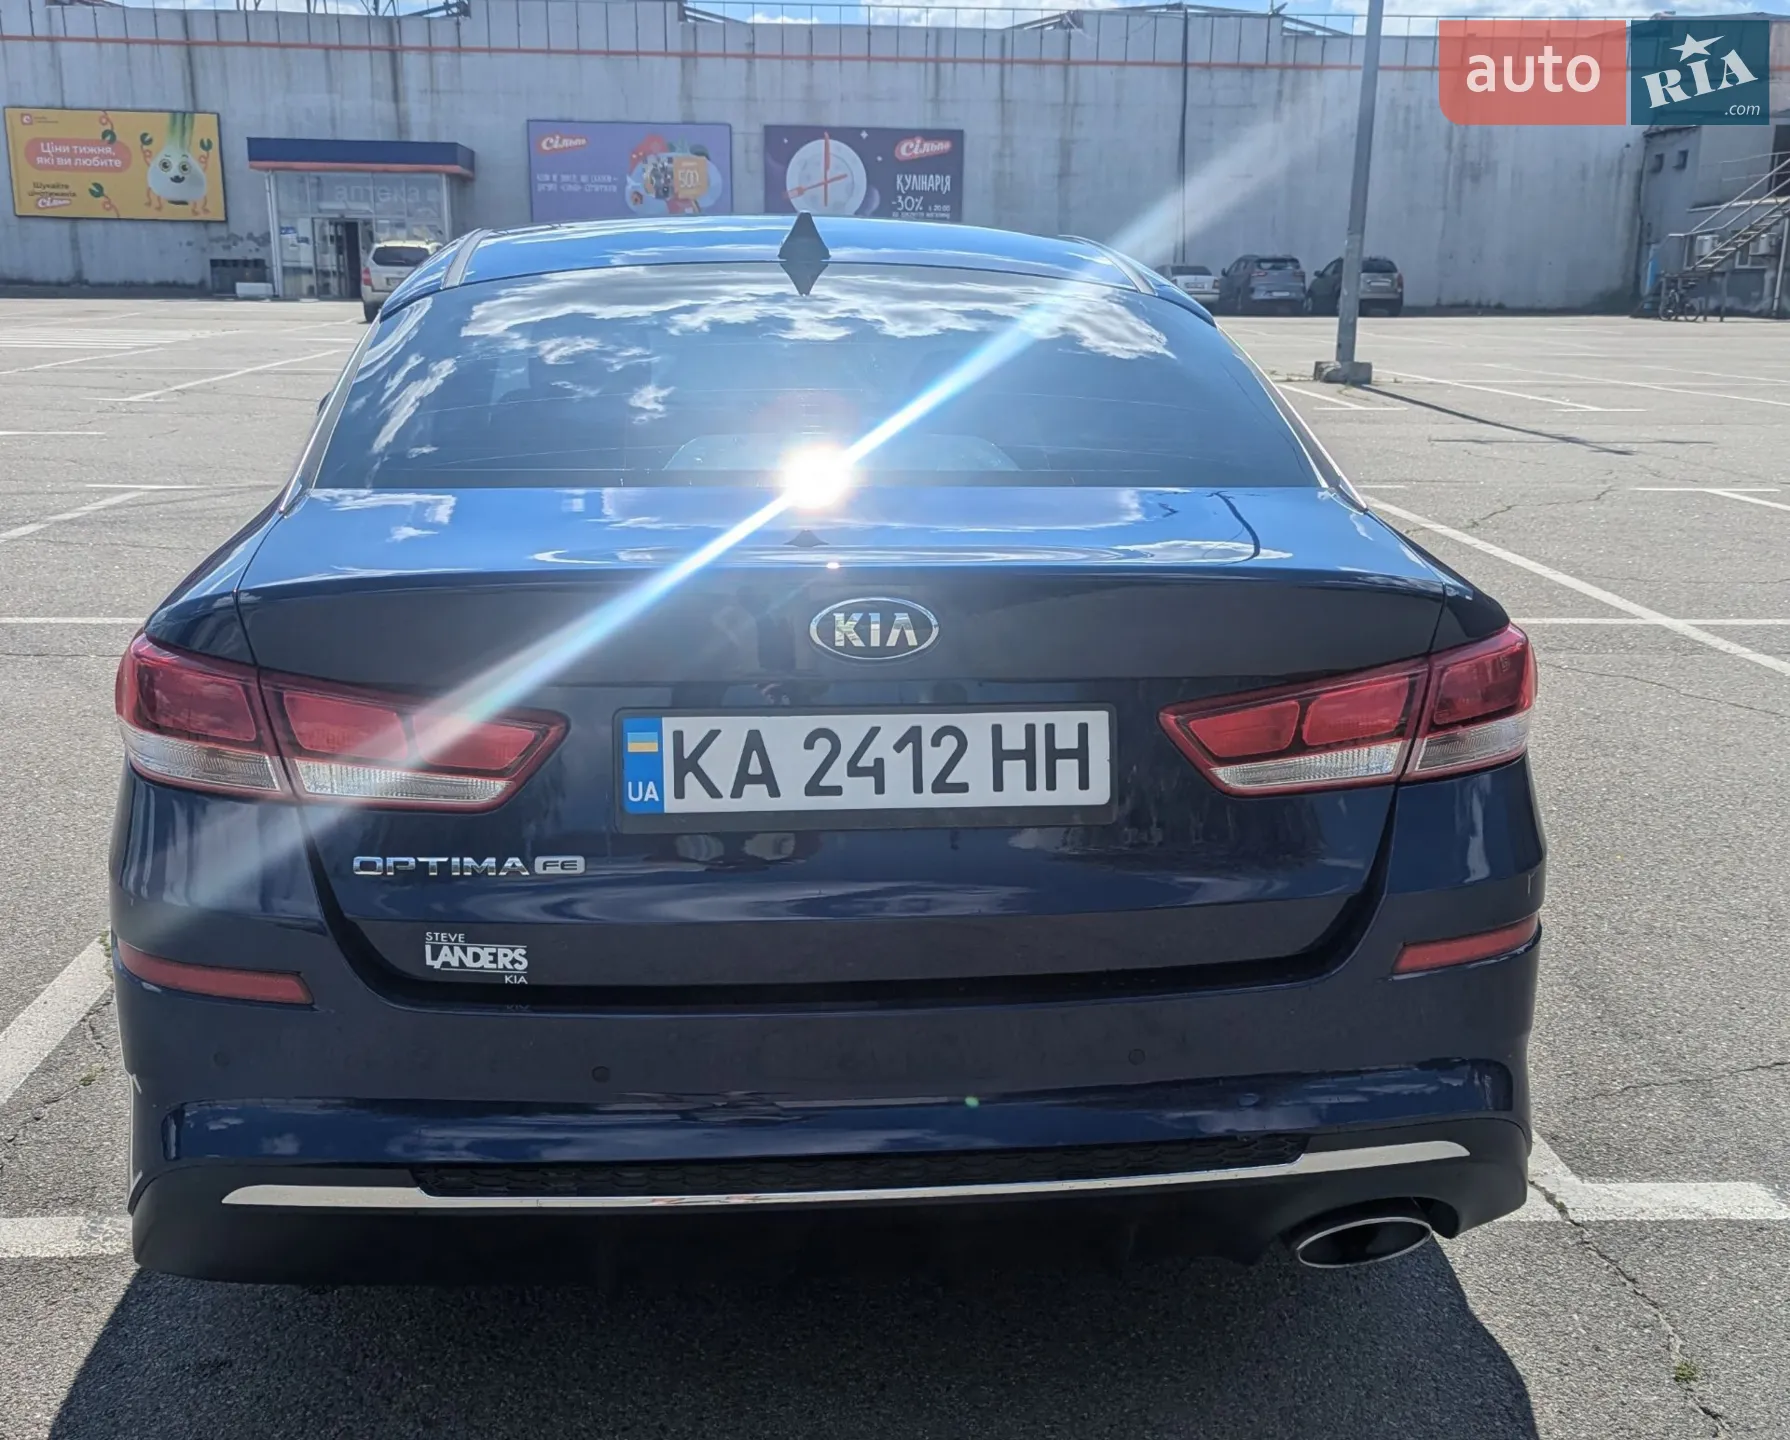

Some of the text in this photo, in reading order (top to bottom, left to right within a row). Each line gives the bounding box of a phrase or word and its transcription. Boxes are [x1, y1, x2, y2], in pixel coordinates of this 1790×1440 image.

[40, 141, 116, 156] Ціни тижня,
[36, 156, 122, 168] які ви любите
[334, 184, 420, 202] аптека
[896, 173, 951, 195] КУЛІНАРІЯ
[891, 195, 924, 212] -30%
[832, 611, 918, 648] KIA
[672, 722, 1090, 800] KA 2412 HH
[627, 782, 660, 802] UA
[352, 855, 531, 876] OPTIMA
[425, 931, 466, 943] STEVE
[424, 943, 529, 971] LANDERS
[504, 974, 529, 985] KIA
